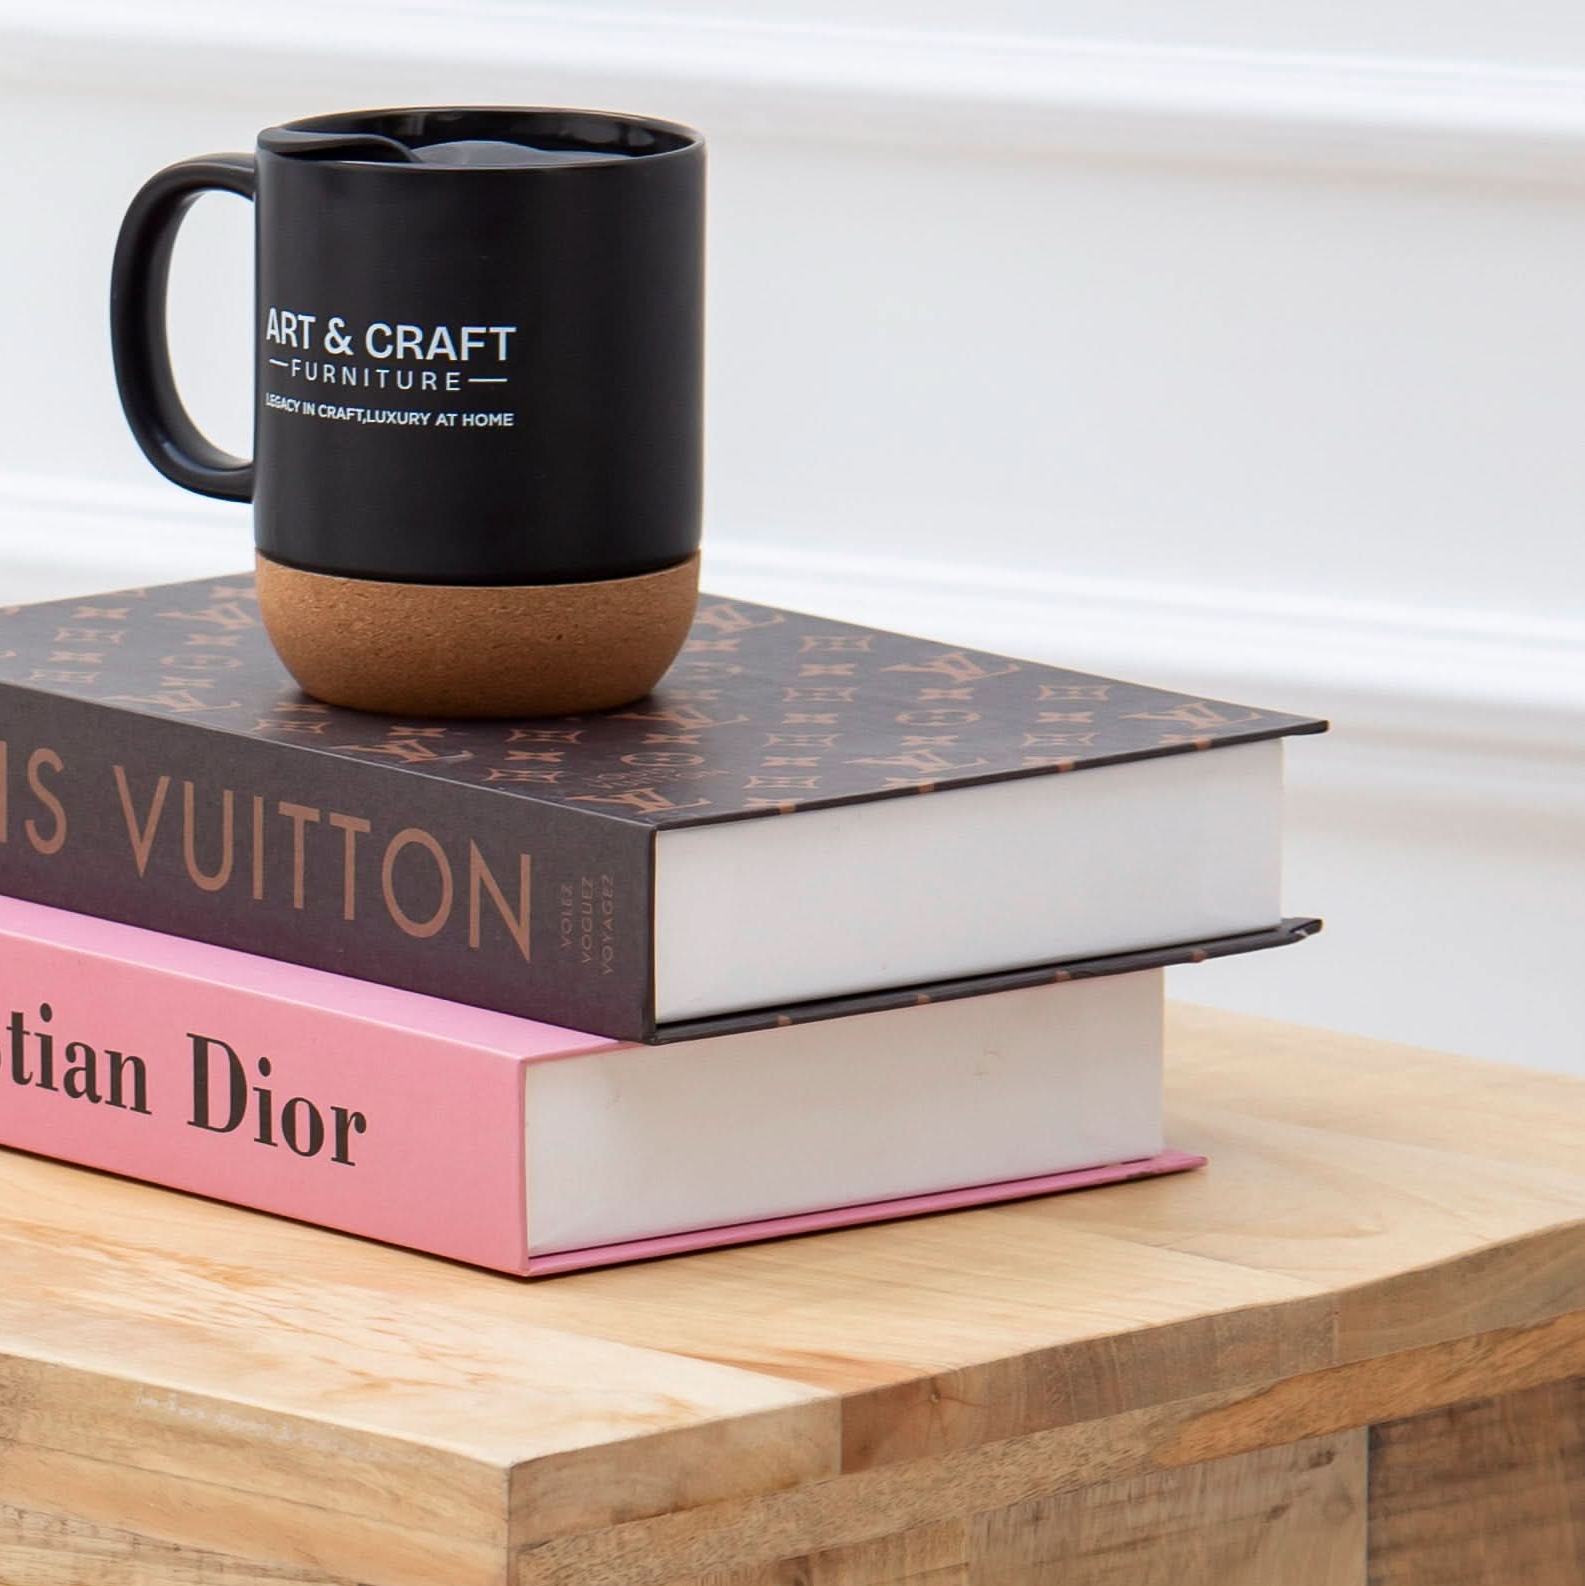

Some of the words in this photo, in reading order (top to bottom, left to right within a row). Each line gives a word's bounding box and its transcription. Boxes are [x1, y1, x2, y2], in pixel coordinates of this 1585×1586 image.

[265, 307, 316, 350] ART
[323, 317, 354, 356] &
[365, 322, 517, 361] CRAFT
[265, 392, 301, 413] LEGACY
[302, 402, 316, 416] IN
[434, 413, 457, 427] AT
[462, 413, 514, 427] HOME
[291, 358, 462, 391] FURNITURE
[113, 764, 532, 963] VUITTON
[601, 874, 614, 975] VOYAGEZ
[186, 1032, 367, 1168] Dior
